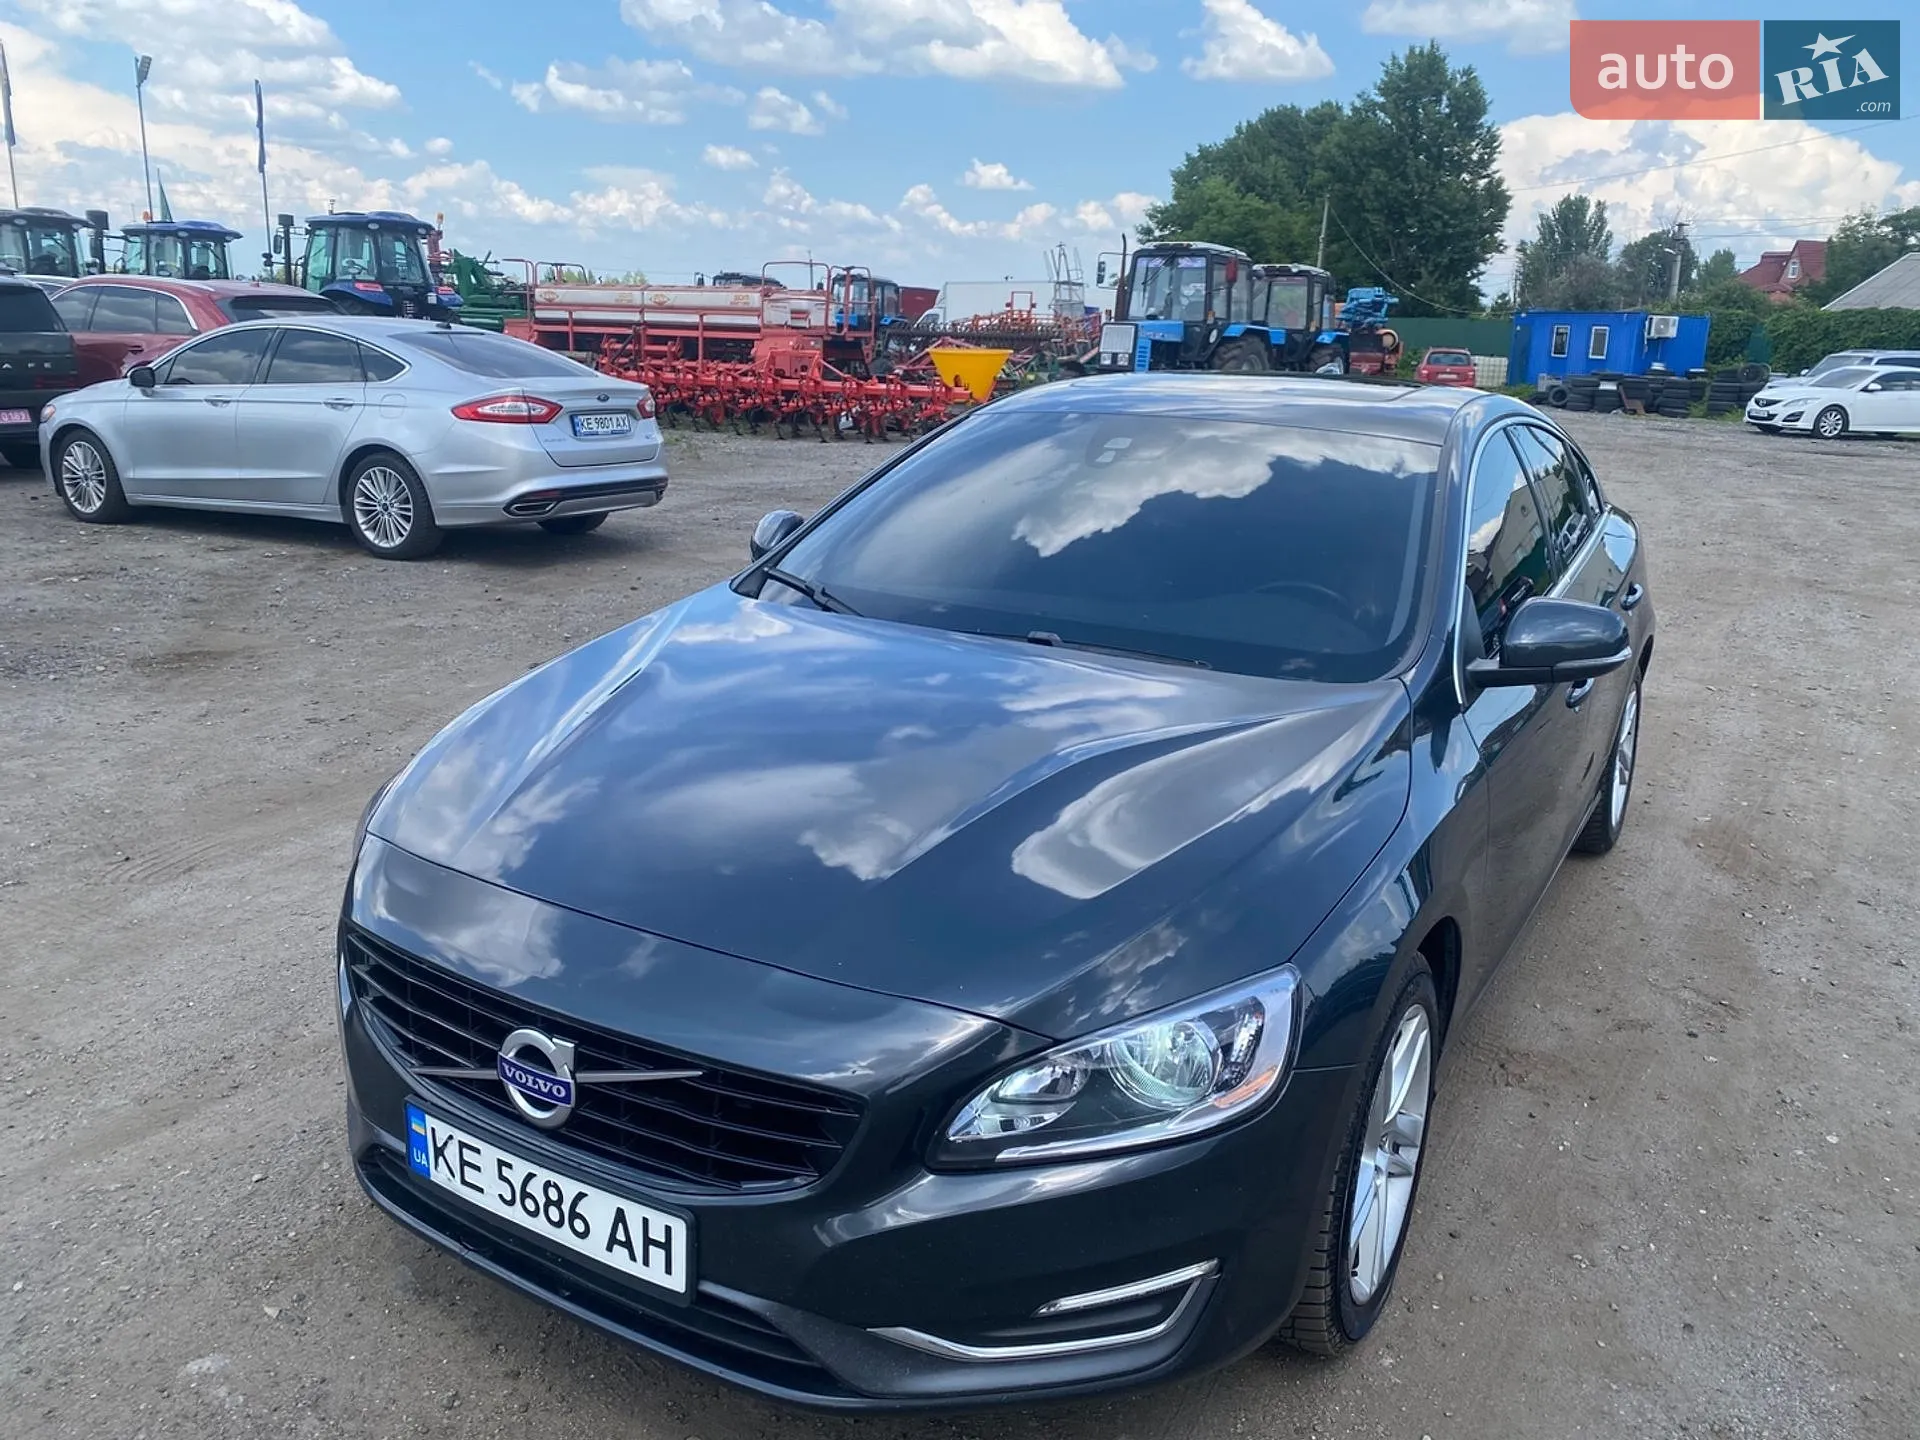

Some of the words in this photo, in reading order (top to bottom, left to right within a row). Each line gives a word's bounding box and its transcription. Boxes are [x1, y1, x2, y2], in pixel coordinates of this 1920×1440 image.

[581, 417, 594, 431] KE
[594, 417, 614, 430] 9801
[616, 416, 628, 430] AX
[501, 1062, 567, 1099] VOLVO
[413, 1147, 429, 1169] UA
[430, 1126, 485, 1195] KE
[496, 1157, 591, 1241] 5686
[605, 1206, 673, 1277] AH
